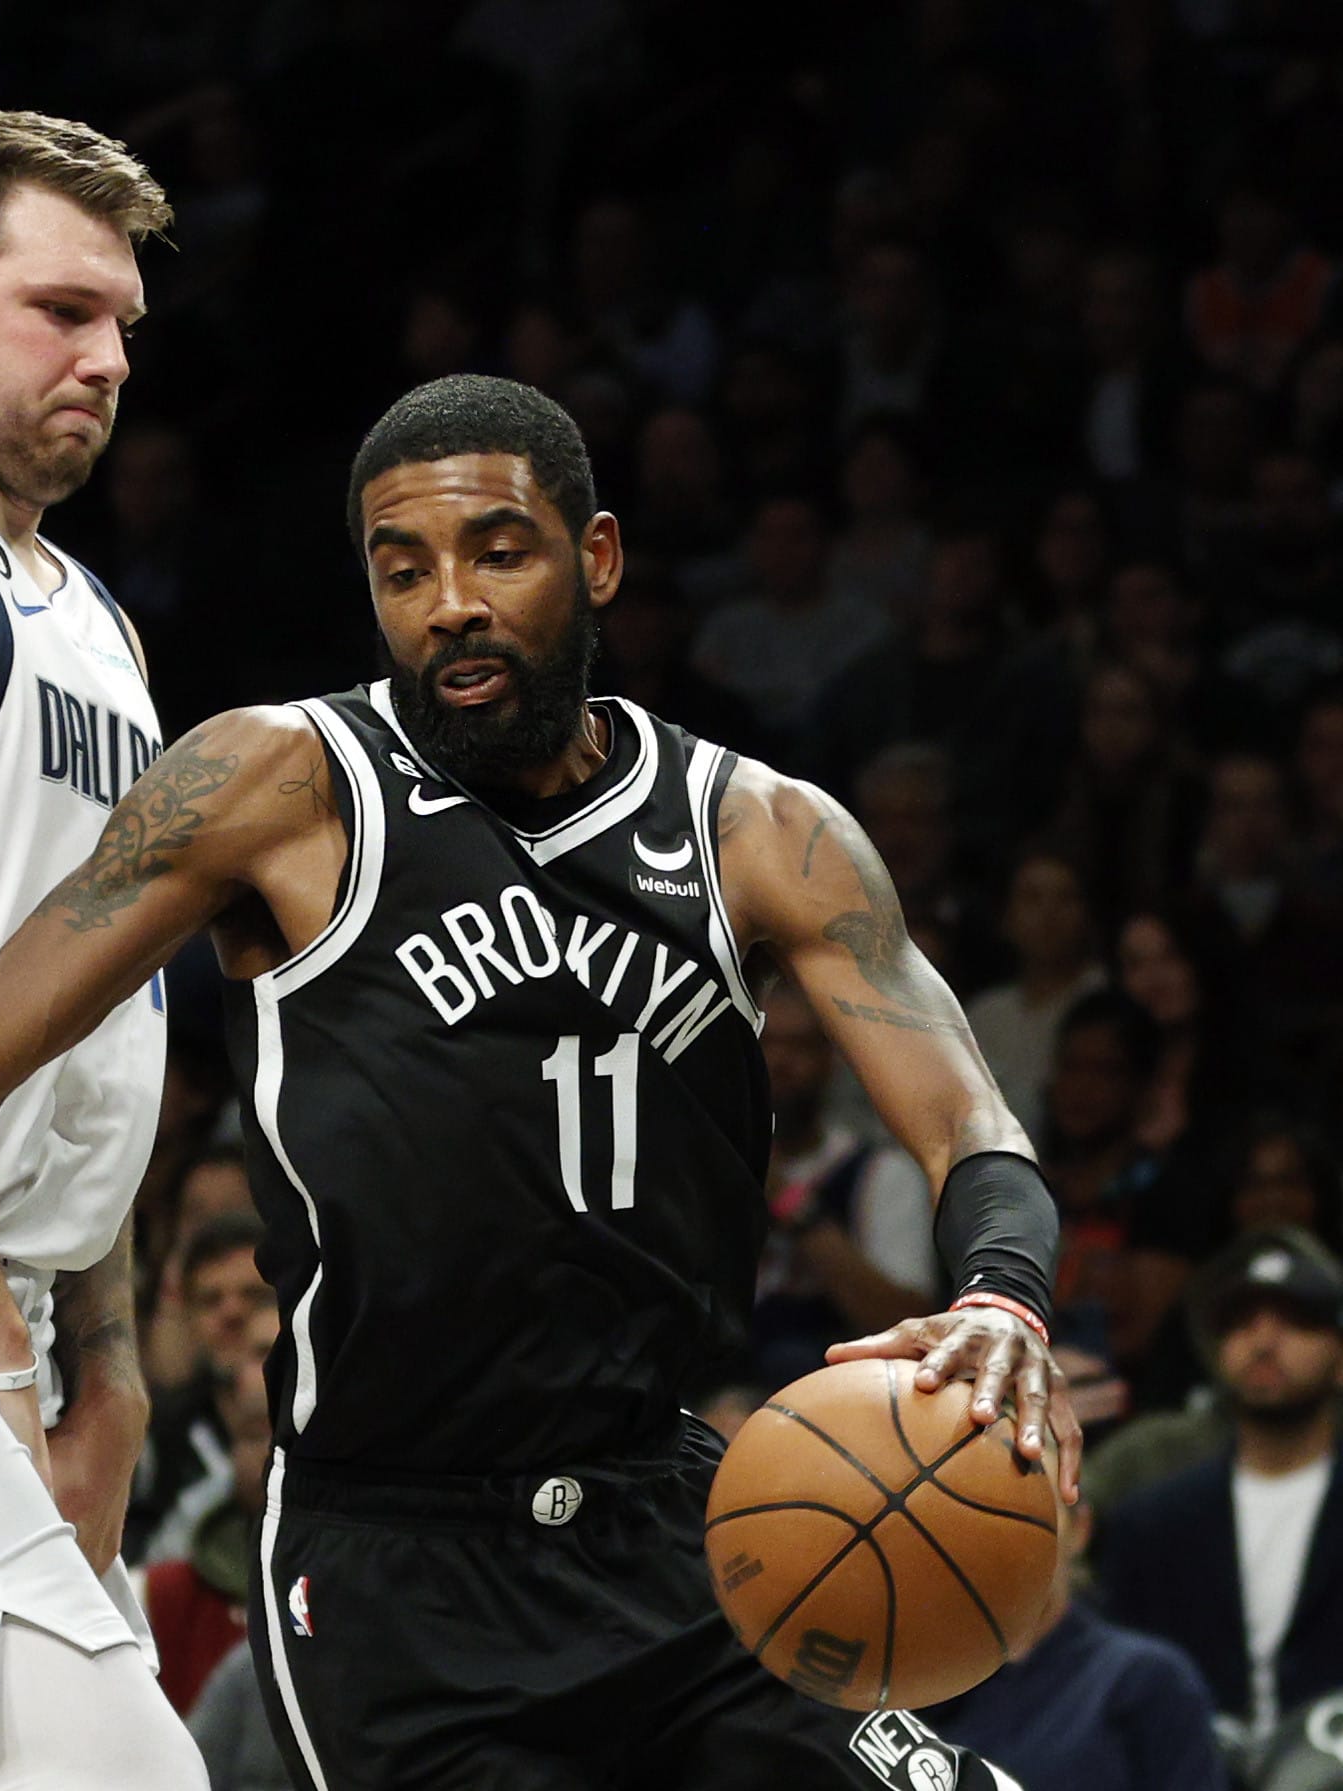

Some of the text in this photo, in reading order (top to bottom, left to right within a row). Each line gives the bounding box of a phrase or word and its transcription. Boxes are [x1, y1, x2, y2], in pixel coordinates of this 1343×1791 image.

[37, 675, 162, 810] DALLA
[389, 752, 424, 779] 6
[636, 874, 700, 898] Webull
[541, 1032, 641, 1213] 11
